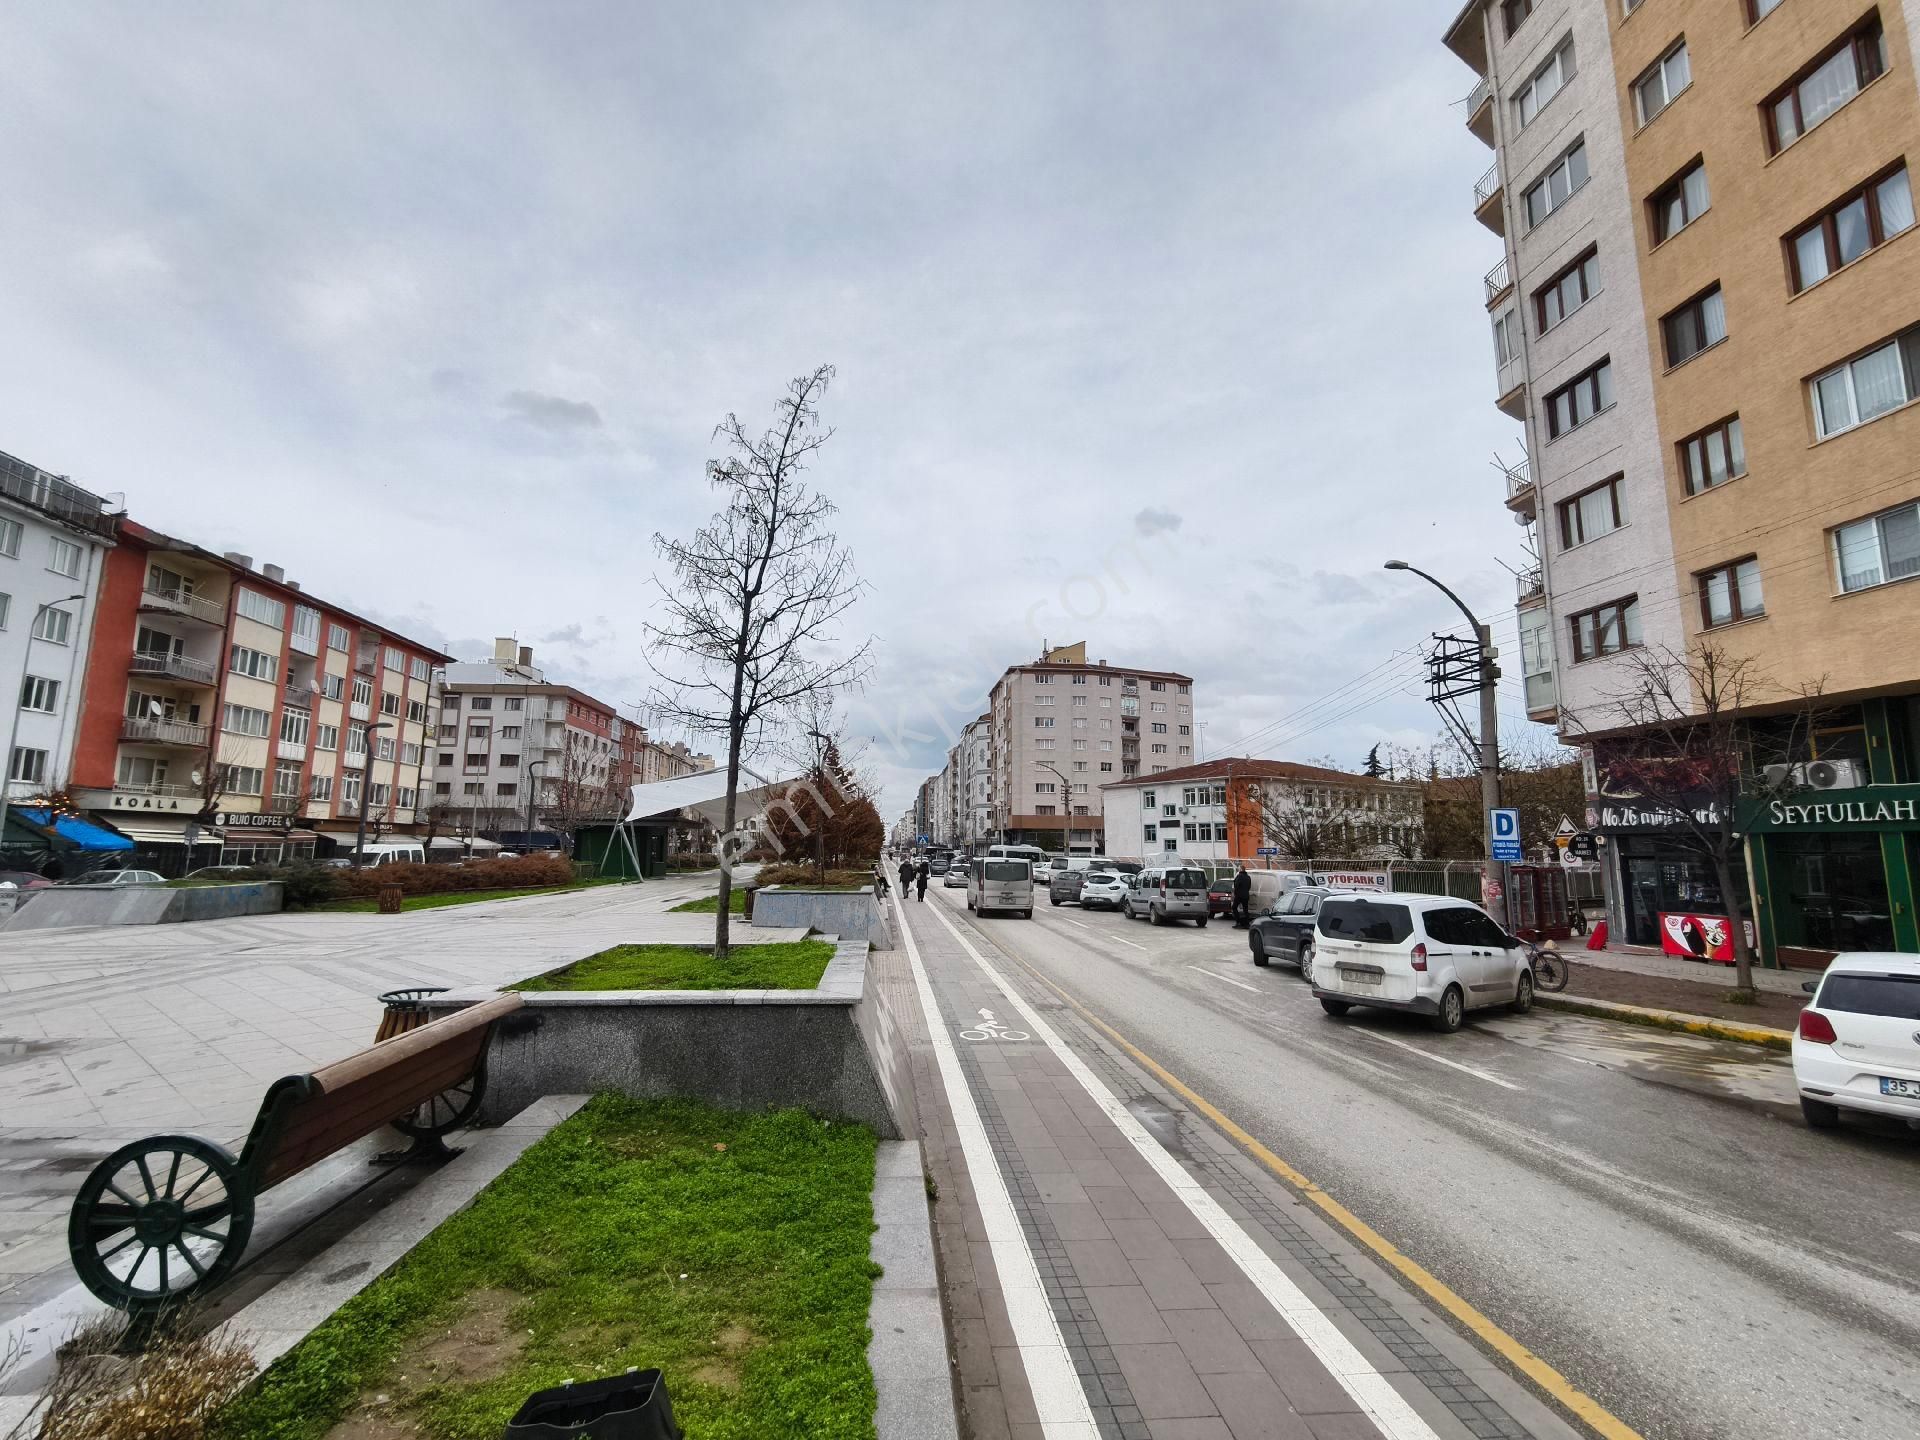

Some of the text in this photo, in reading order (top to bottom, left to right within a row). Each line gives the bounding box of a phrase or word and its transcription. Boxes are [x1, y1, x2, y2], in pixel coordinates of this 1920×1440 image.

[115, 797, 179, 809] KOALA
[1602, 807, 1638, 826] No.26
[1770, 800, 1917, 825] SEYFULLAH
[251, 815, 283, 826] COFFEE
[1496, 813, 1513, 836] D
[1327, 875, 1375, 885] OTOPARK
[1890, 1080, 1908, 1092] 35
